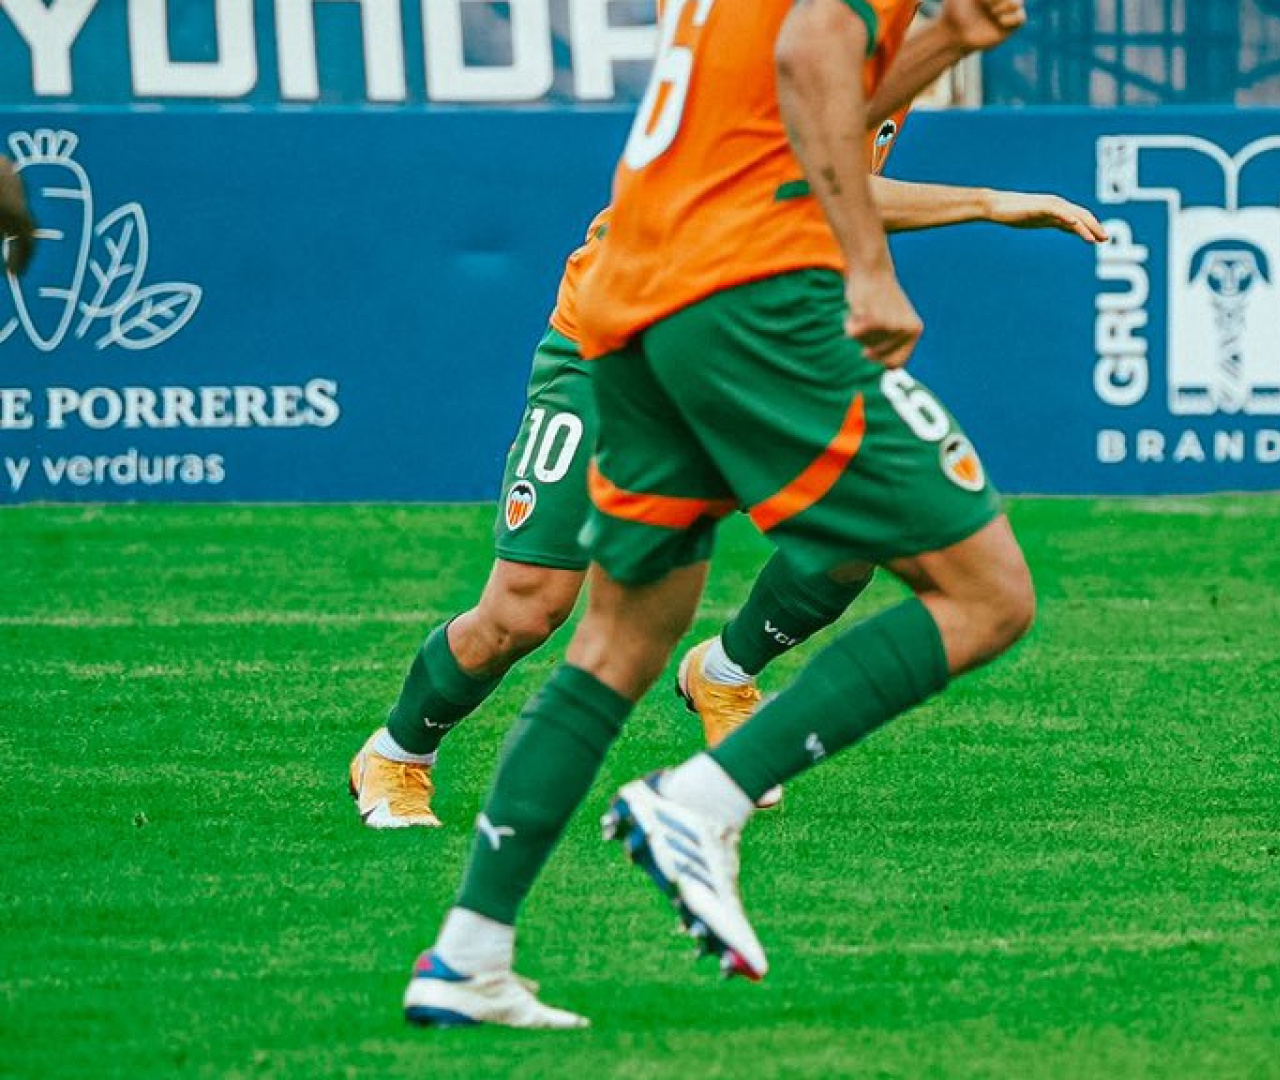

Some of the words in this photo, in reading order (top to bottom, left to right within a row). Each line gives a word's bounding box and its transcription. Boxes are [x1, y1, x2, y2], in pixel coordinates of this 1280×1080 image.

[1093, 218, 1150, 407] GRUP
[0, 387, 34, 430] E
[46, 378, 341, 429] PORRERES
[880, 367, 950, 441] 6
[5, 455, 31, 492] y
[42, 447, 226, 486] verduras
[515, 407, 584, 483] 10
